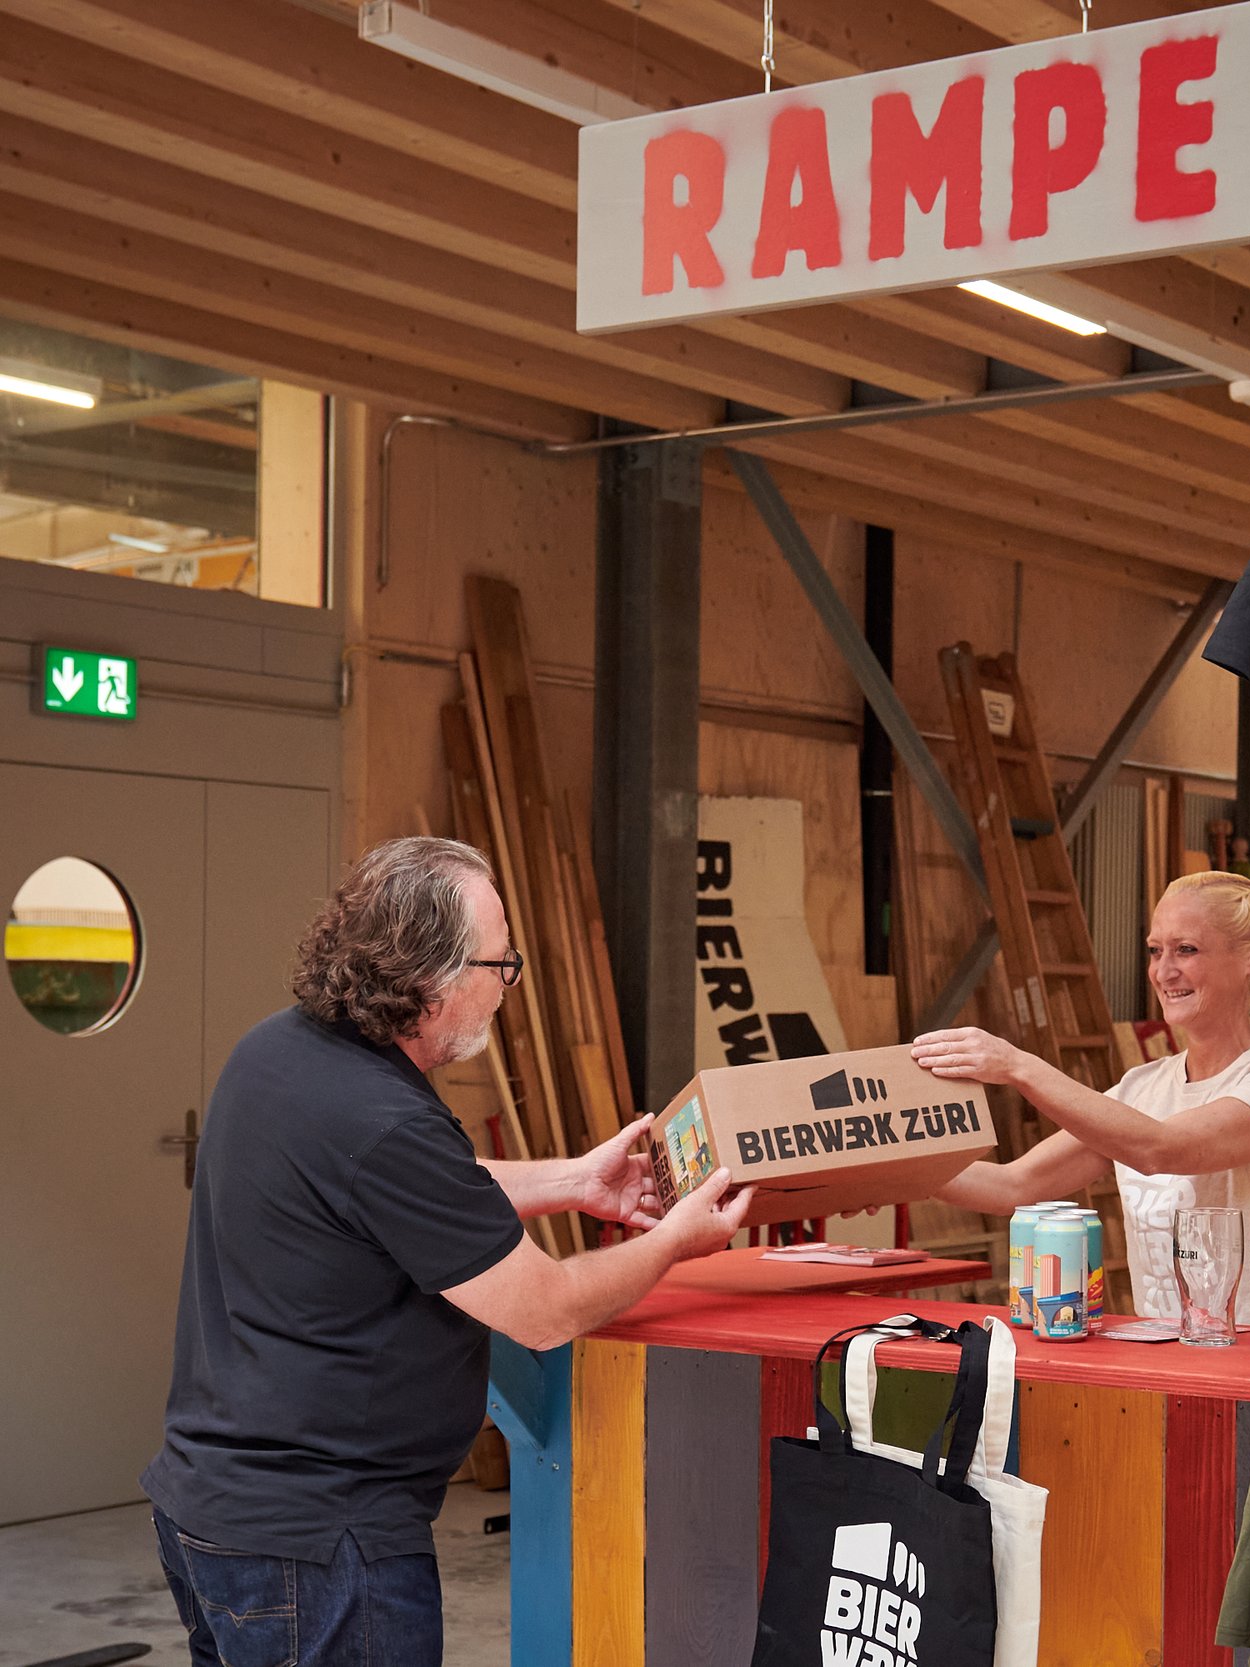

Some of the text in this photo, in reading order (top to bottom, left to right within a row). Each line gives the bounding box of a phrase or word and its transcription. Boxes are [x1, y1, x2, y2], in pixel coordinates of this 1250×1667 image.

[641, 33, 1220, 296] RAMPE
[900, 1100, 982, 1142] ZÜRI
[824, 1575, 922, 1661] BIER
